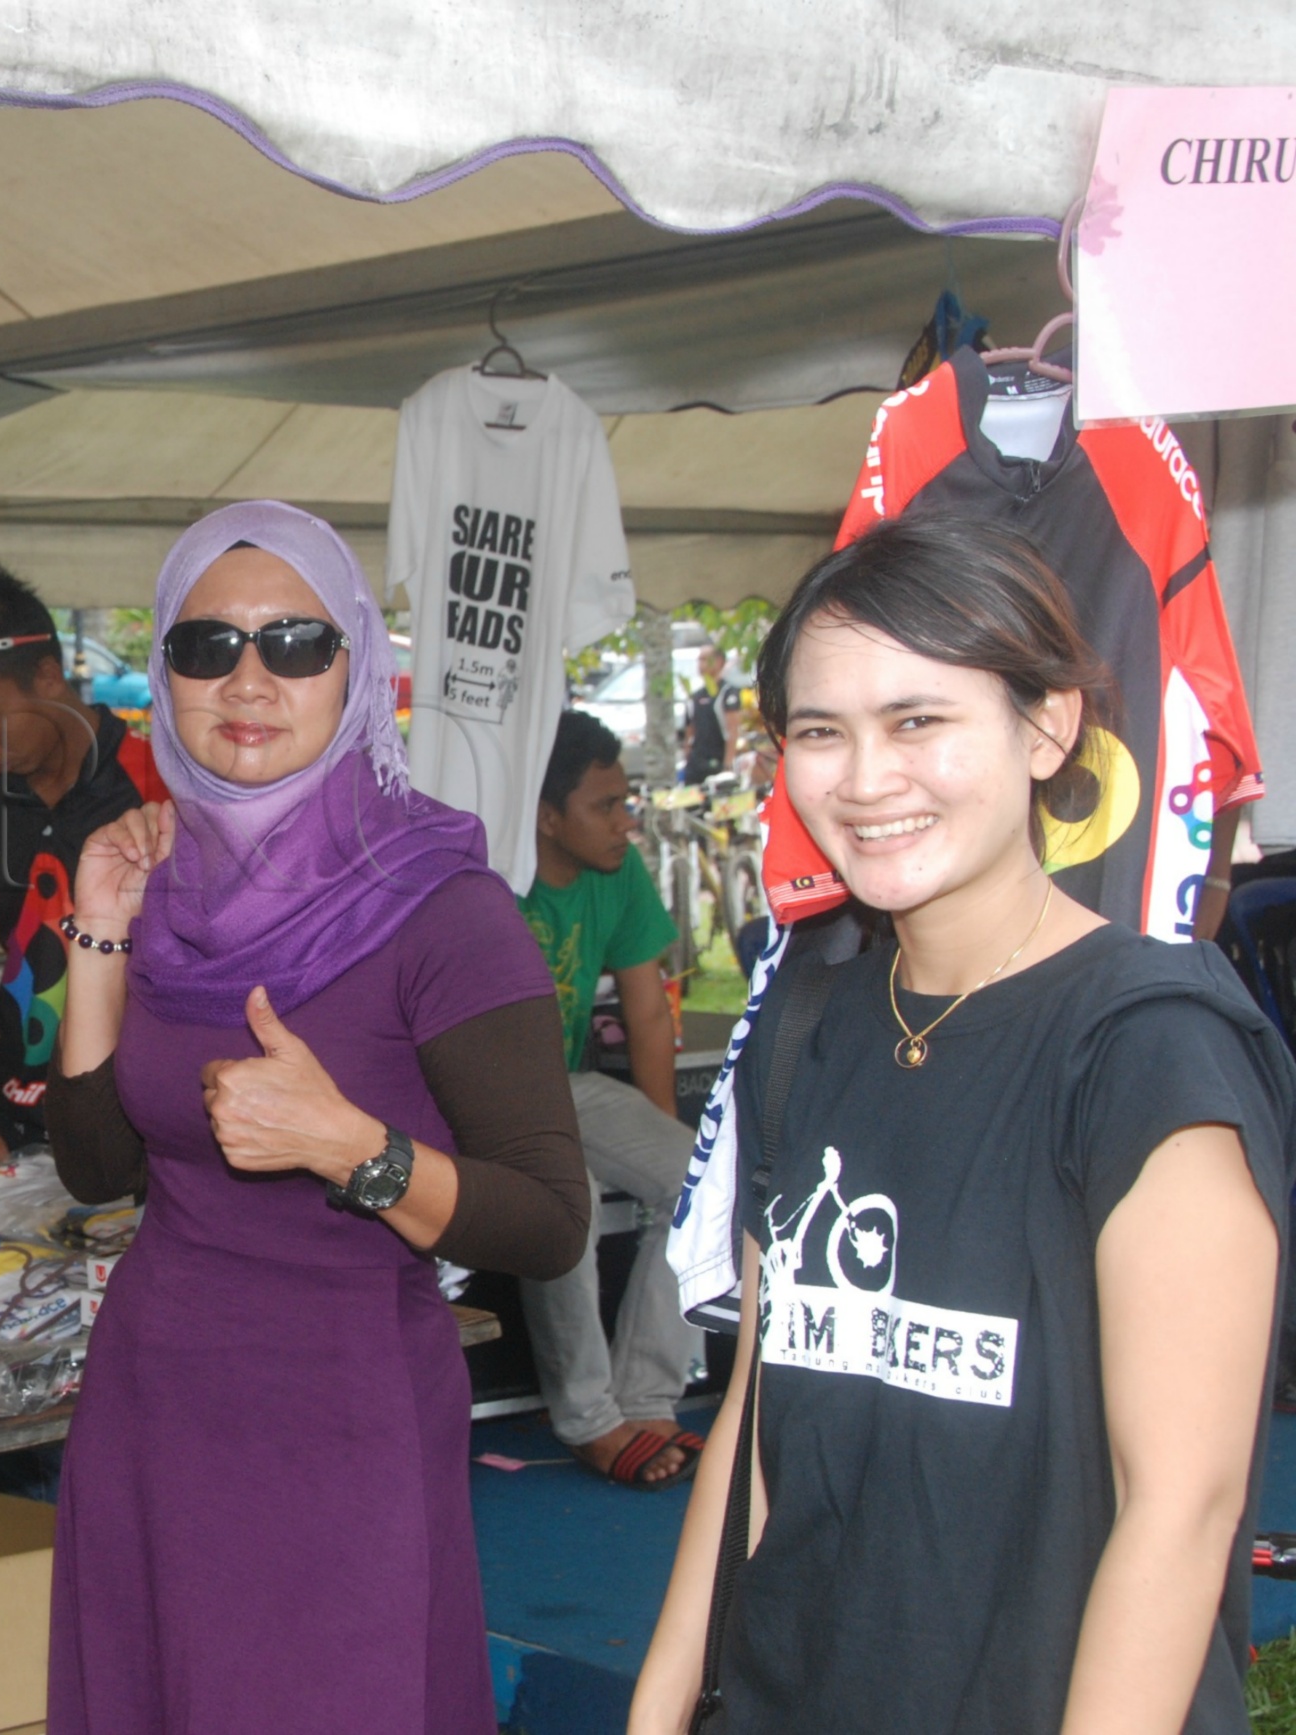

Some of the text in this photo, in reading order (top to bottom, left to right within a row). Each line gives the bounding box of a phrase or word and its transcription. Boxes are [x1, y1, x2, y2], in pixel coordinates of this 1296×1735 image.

[1160, 137, 1296, 185] CHIRU
[458, 658, 494, 677] 1.5m
[448, 687, 490, 708] 5 feet
